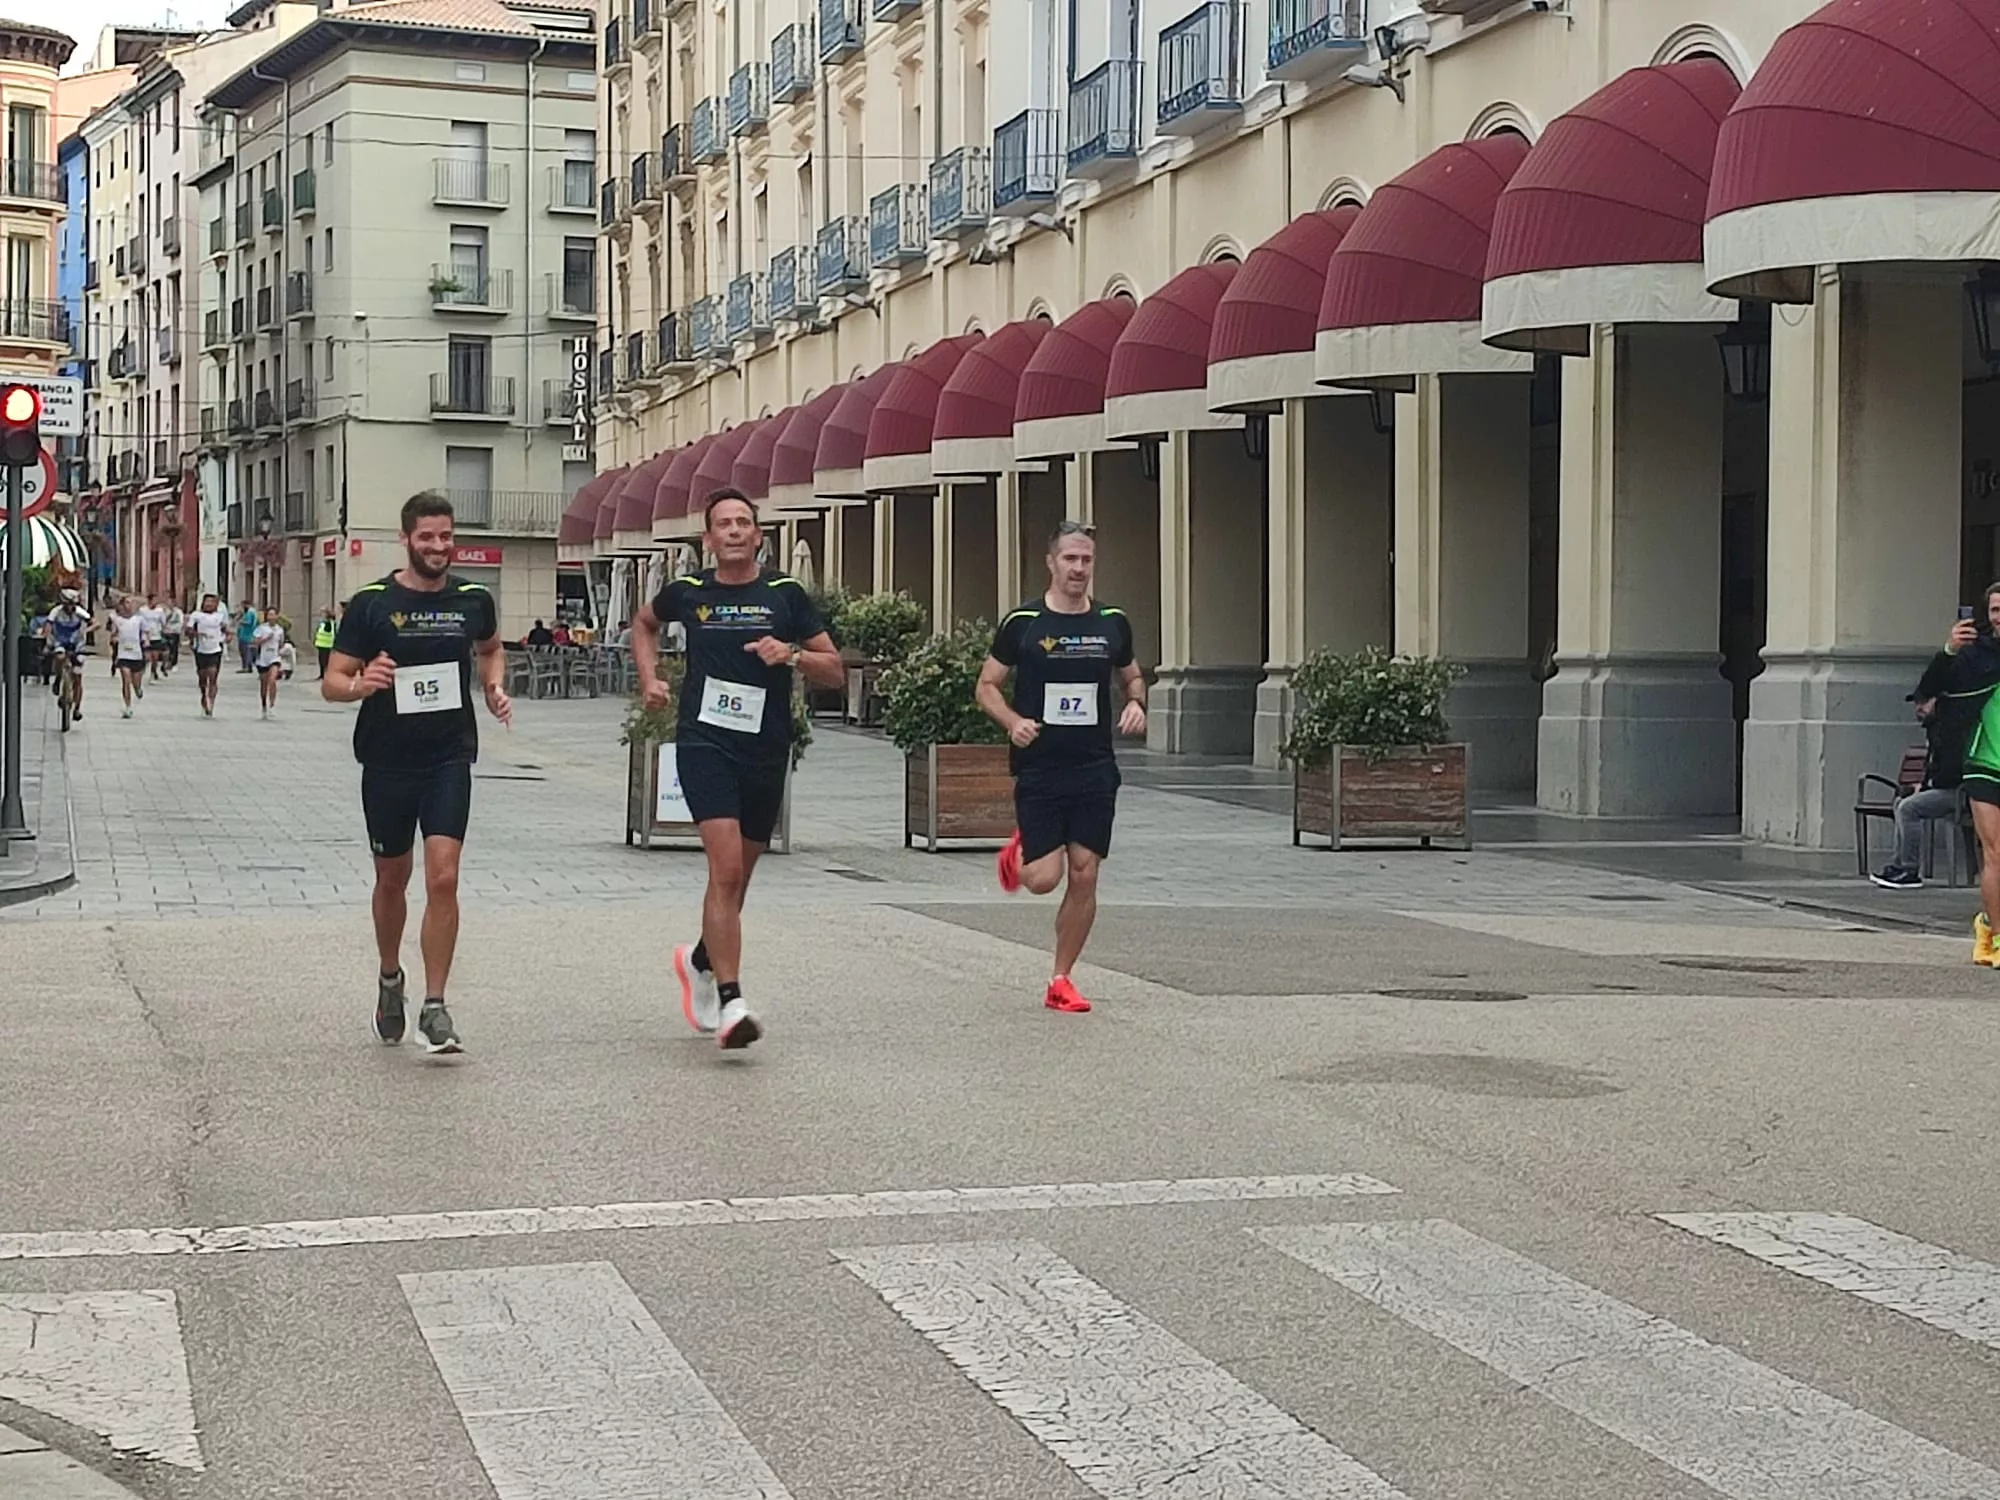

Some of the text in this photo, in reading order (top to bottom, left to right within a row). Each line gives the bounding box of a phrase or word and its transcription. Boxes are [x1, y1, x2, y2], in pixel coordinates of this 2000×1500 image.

[34, 384, 73, 394] ANCIA
[573, 336, 588, 441] HOSTAL
[413, 679, 439, 697] 85
[718, 694, 743, 712] 86
[1059, 697, 1083, 711] 87
